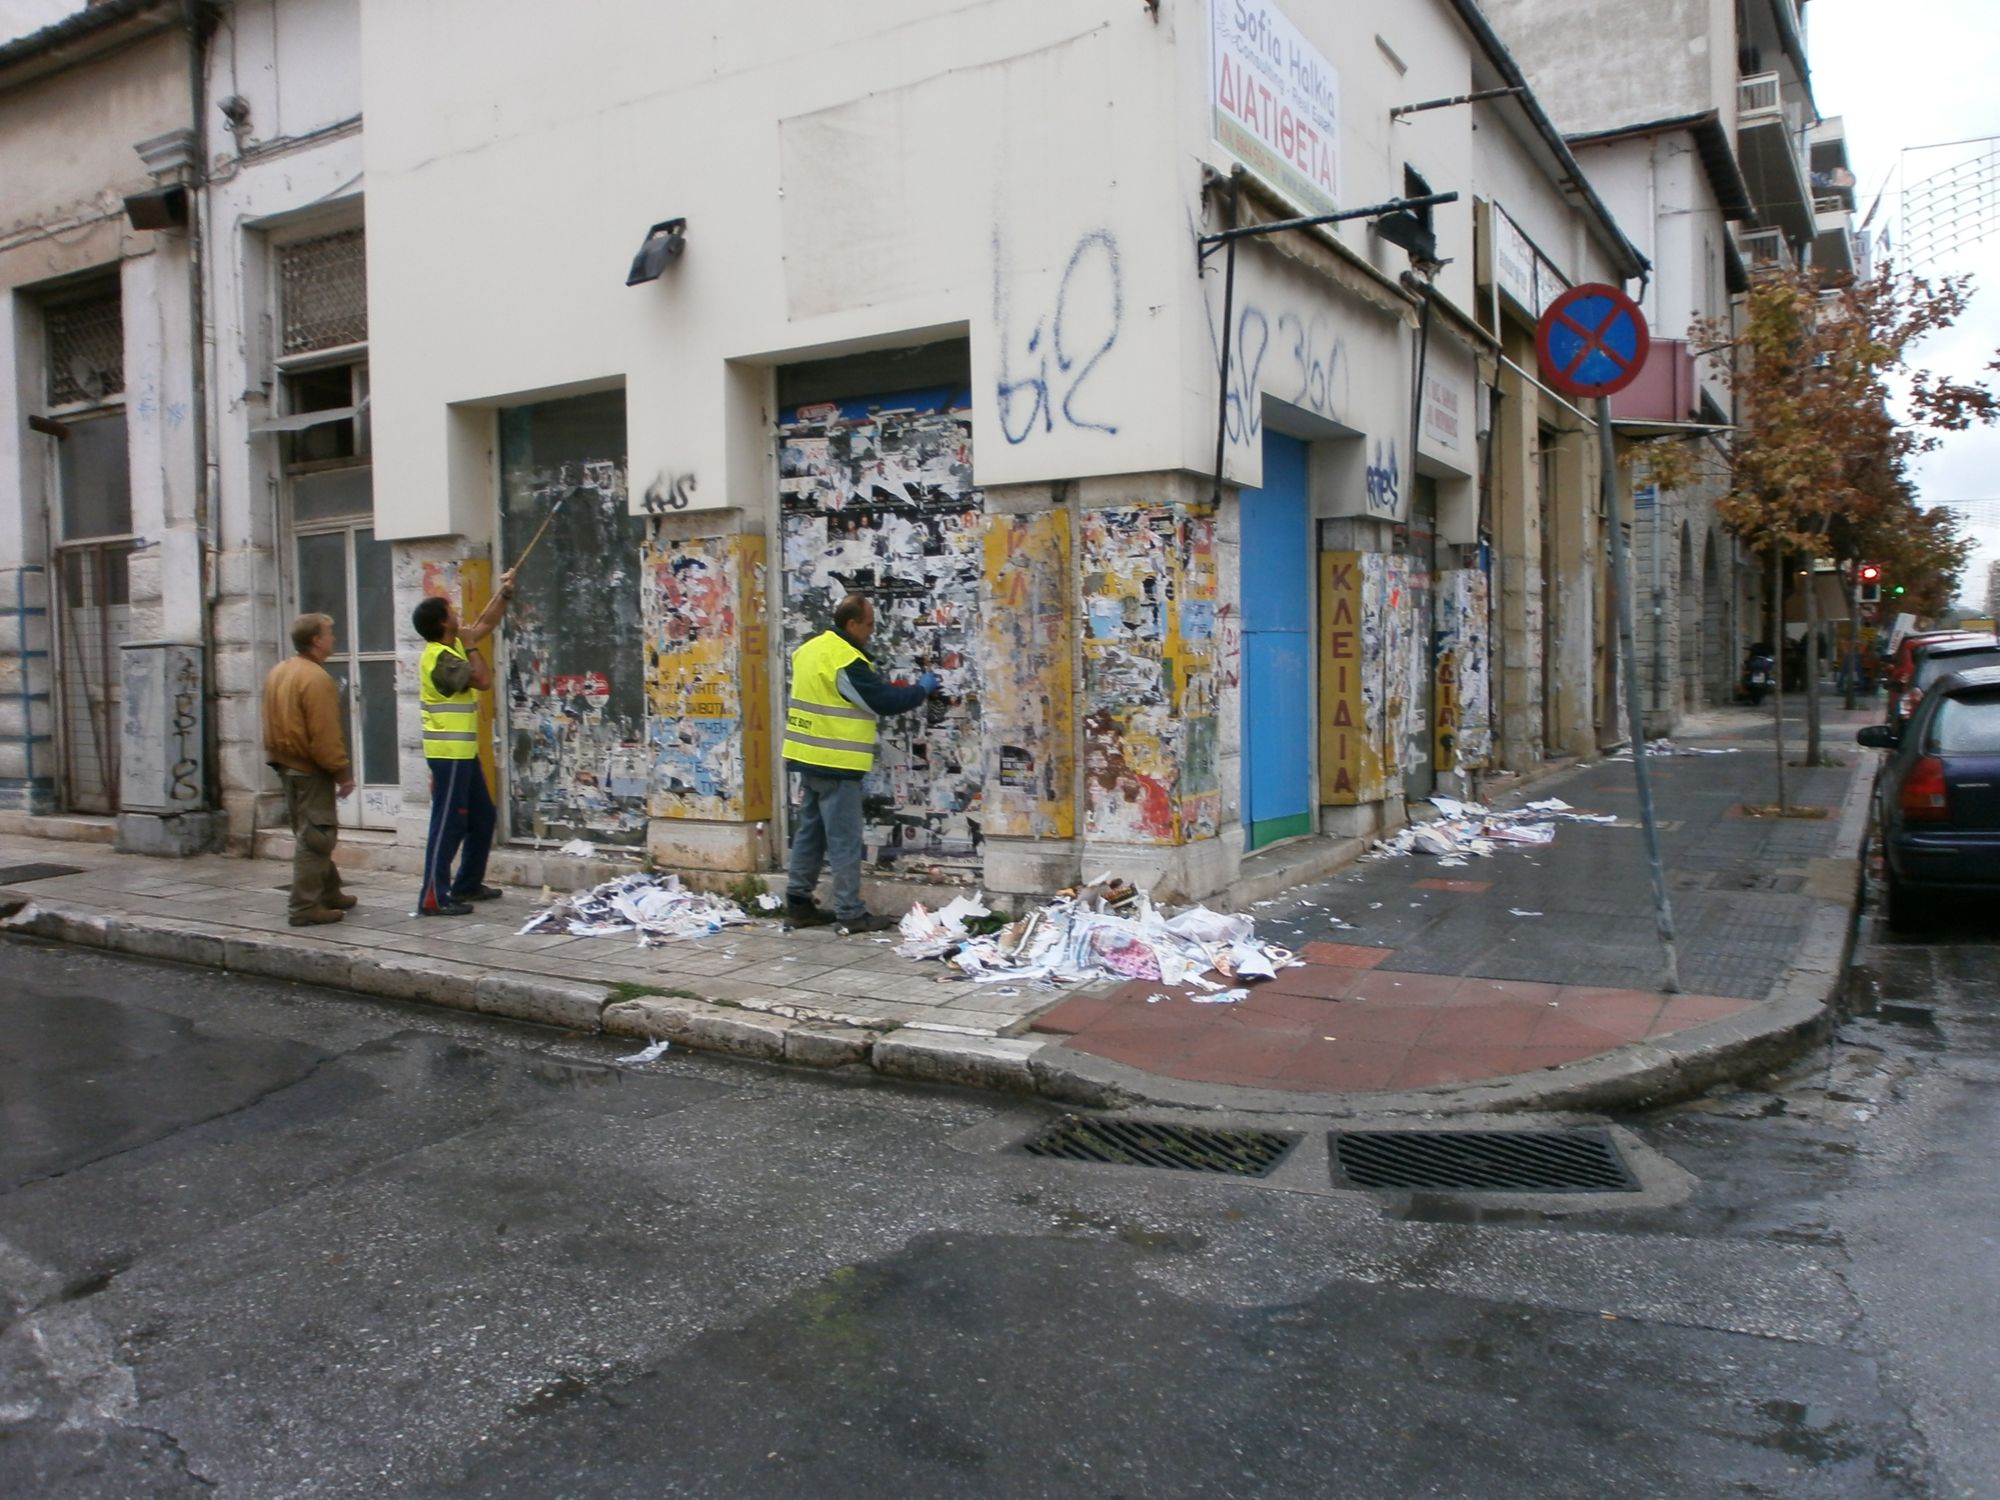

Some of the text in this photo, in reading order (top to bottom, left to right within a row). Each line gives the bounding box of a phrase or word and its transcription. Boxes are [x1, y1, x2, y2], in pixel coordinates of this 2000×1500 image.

[1220, 52, 1337, 196] ΔΙΑΤΙΘΕΤΑΙ
[1234, 0, 1336, 120] Sofia Halkia
[1332, 563, 1353, 794] ΚΛΕΙΔΙΑ
